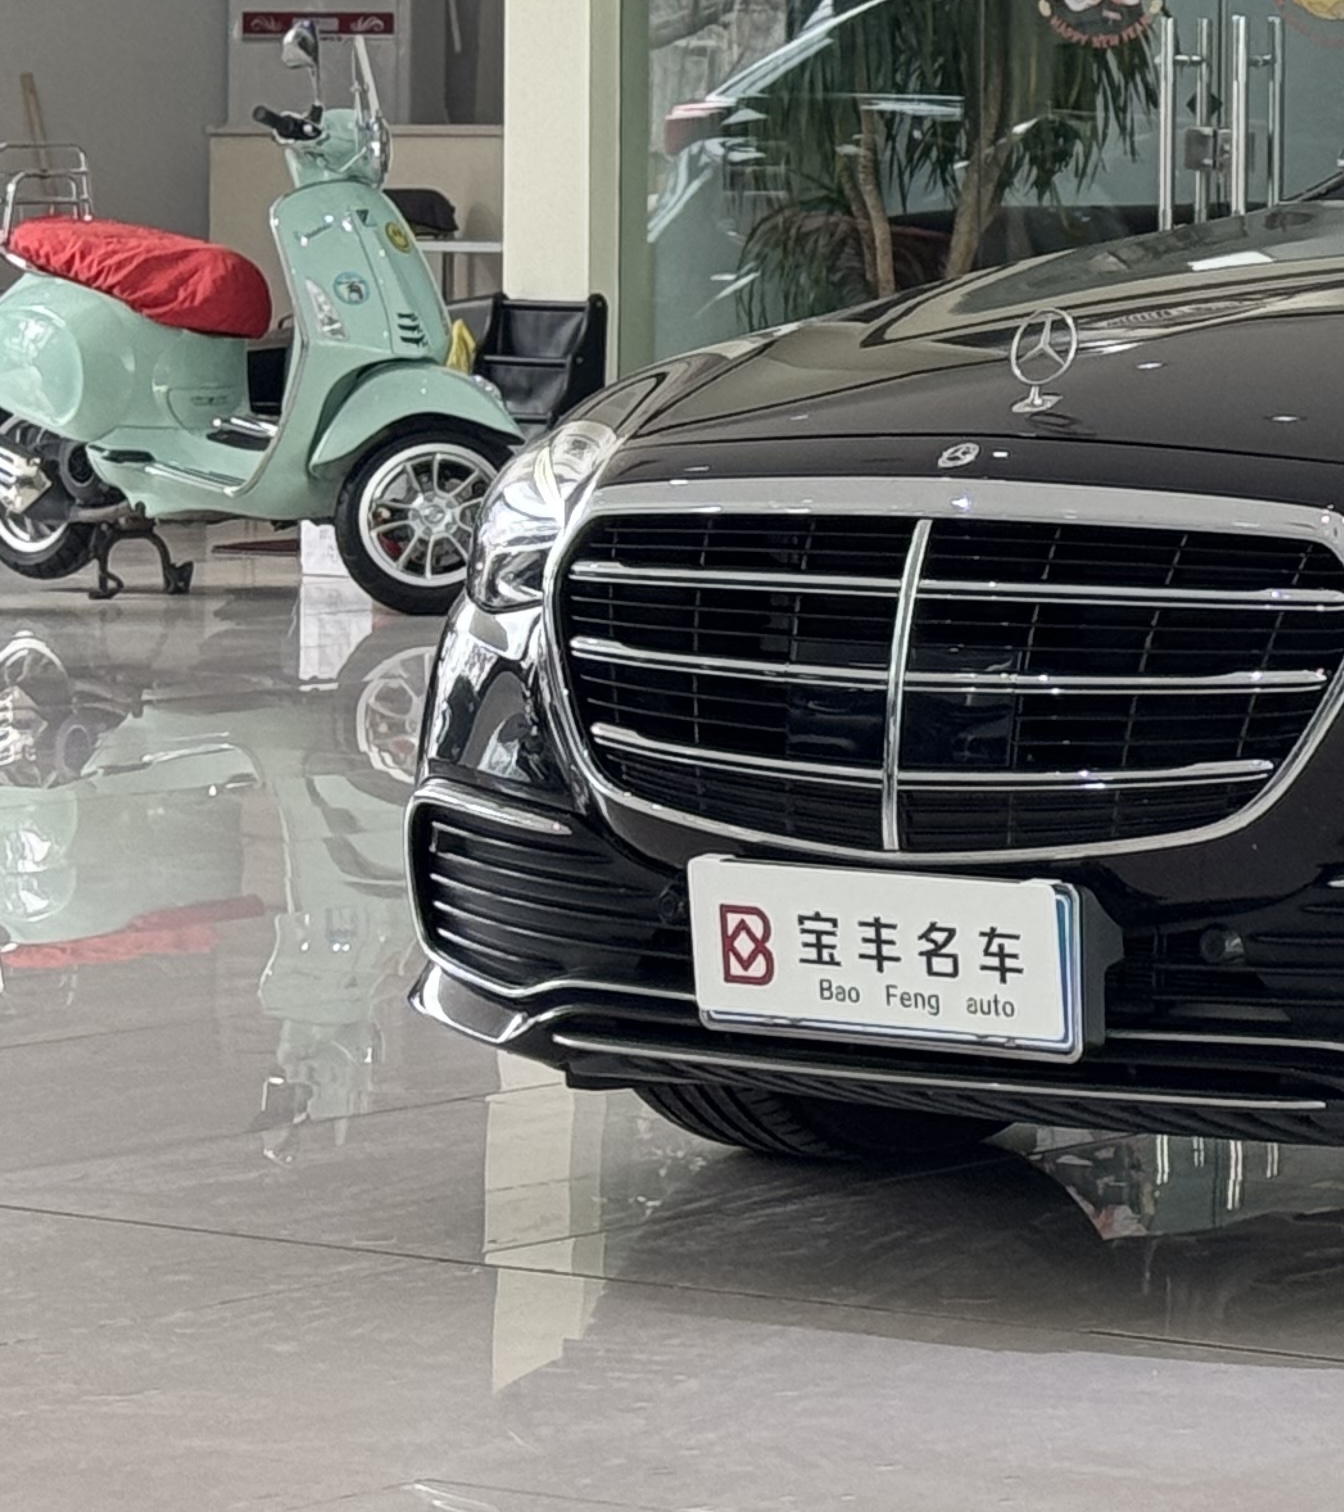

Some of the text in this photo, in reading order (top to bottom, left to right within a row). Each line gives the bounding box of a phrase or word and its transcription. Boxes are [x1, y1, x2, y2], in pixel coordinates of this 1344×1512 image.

[797, 910, 1024, 985] 宝丰名车
[819, 978, 1015, 1017] Bao Feng auto
